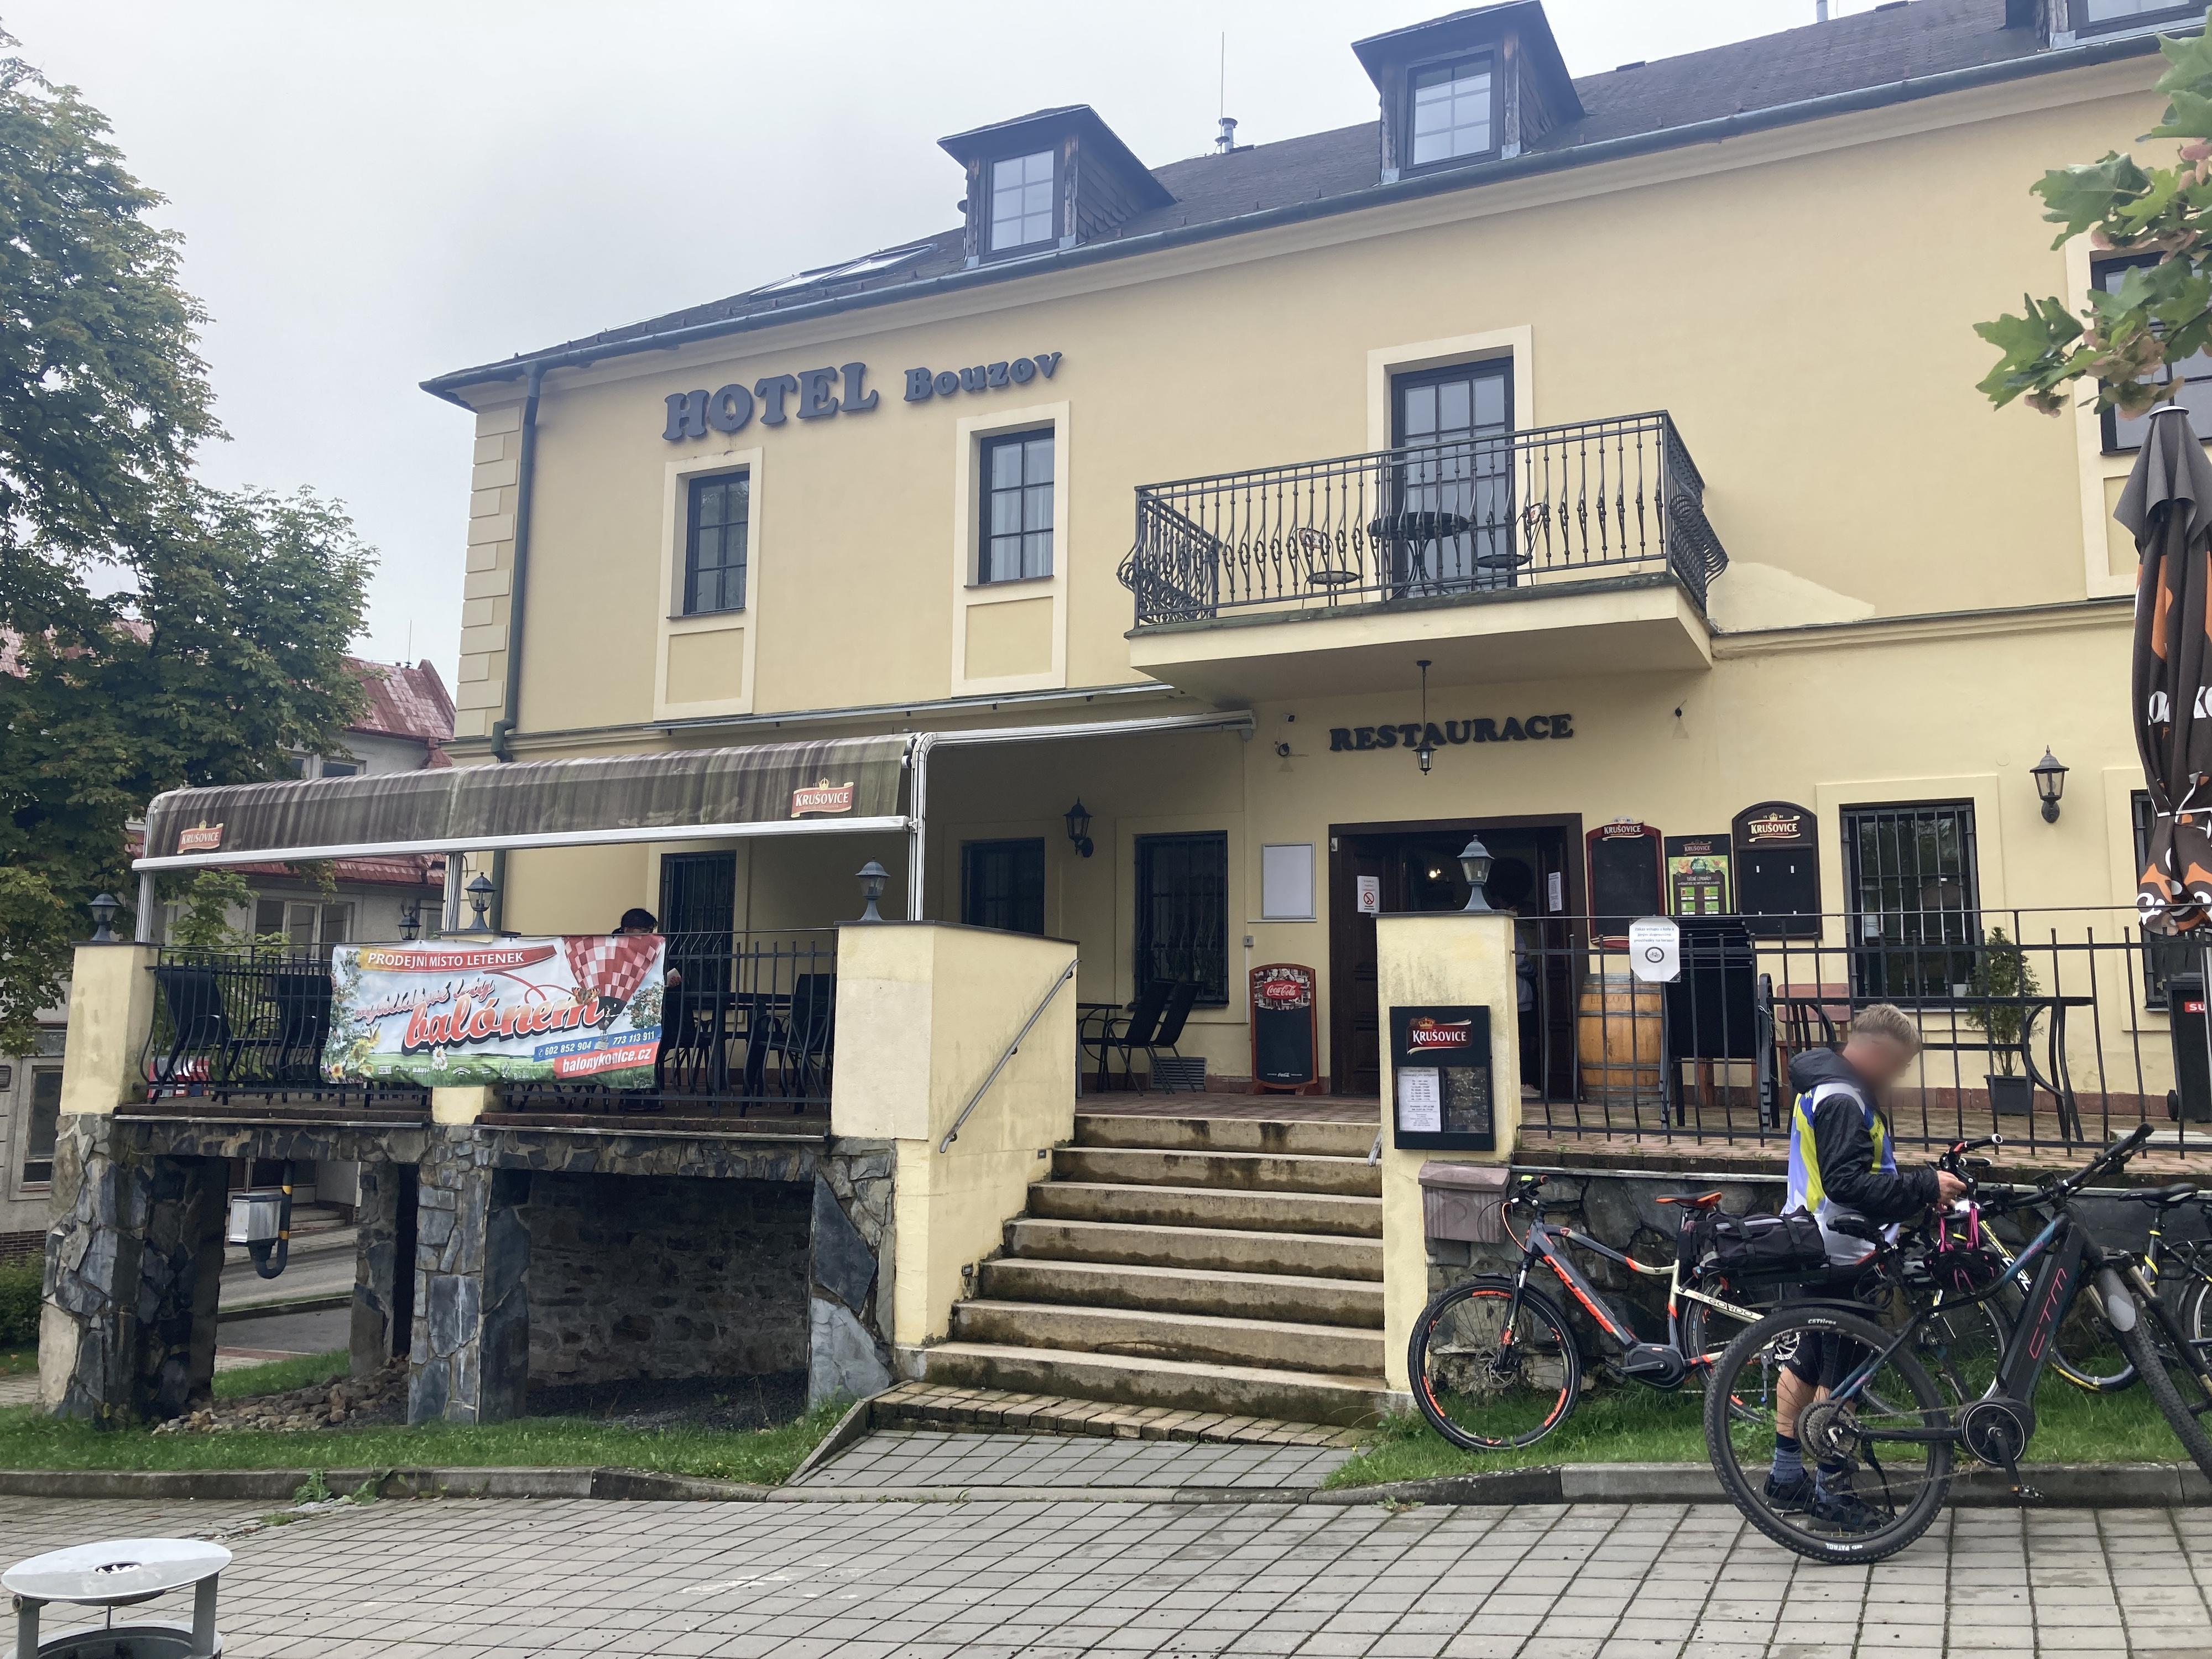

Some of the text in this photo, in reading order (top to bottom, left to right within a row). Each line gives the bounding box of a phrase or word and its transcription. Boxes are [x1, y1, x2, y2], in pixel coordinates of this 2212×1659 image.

[662, 351, 1063, 441] HOTEL Bouzov
[1329, 713, 1574, 752] RESTAURACE
[795, 792, 849, 807] KRUŠOVICE
[1604, 825, 1641, 834] KRUŠOVICE
[1751, 823, 1797, 834] KRUŠOVICE
[181, 832, 220, 845] KRUŠOVICE
[368, 952, 524, 968] PRODEJNÍ MÍSTO LETENEK
[403, 994, 605, 1052] balónem
[545, 1031, 655, 1056] 602 852 904 773 113 911
[1412, 1030, 1467, 1045] KRUŠOVICE
[562, 1048, 652, 1073] balonykonice.cz
